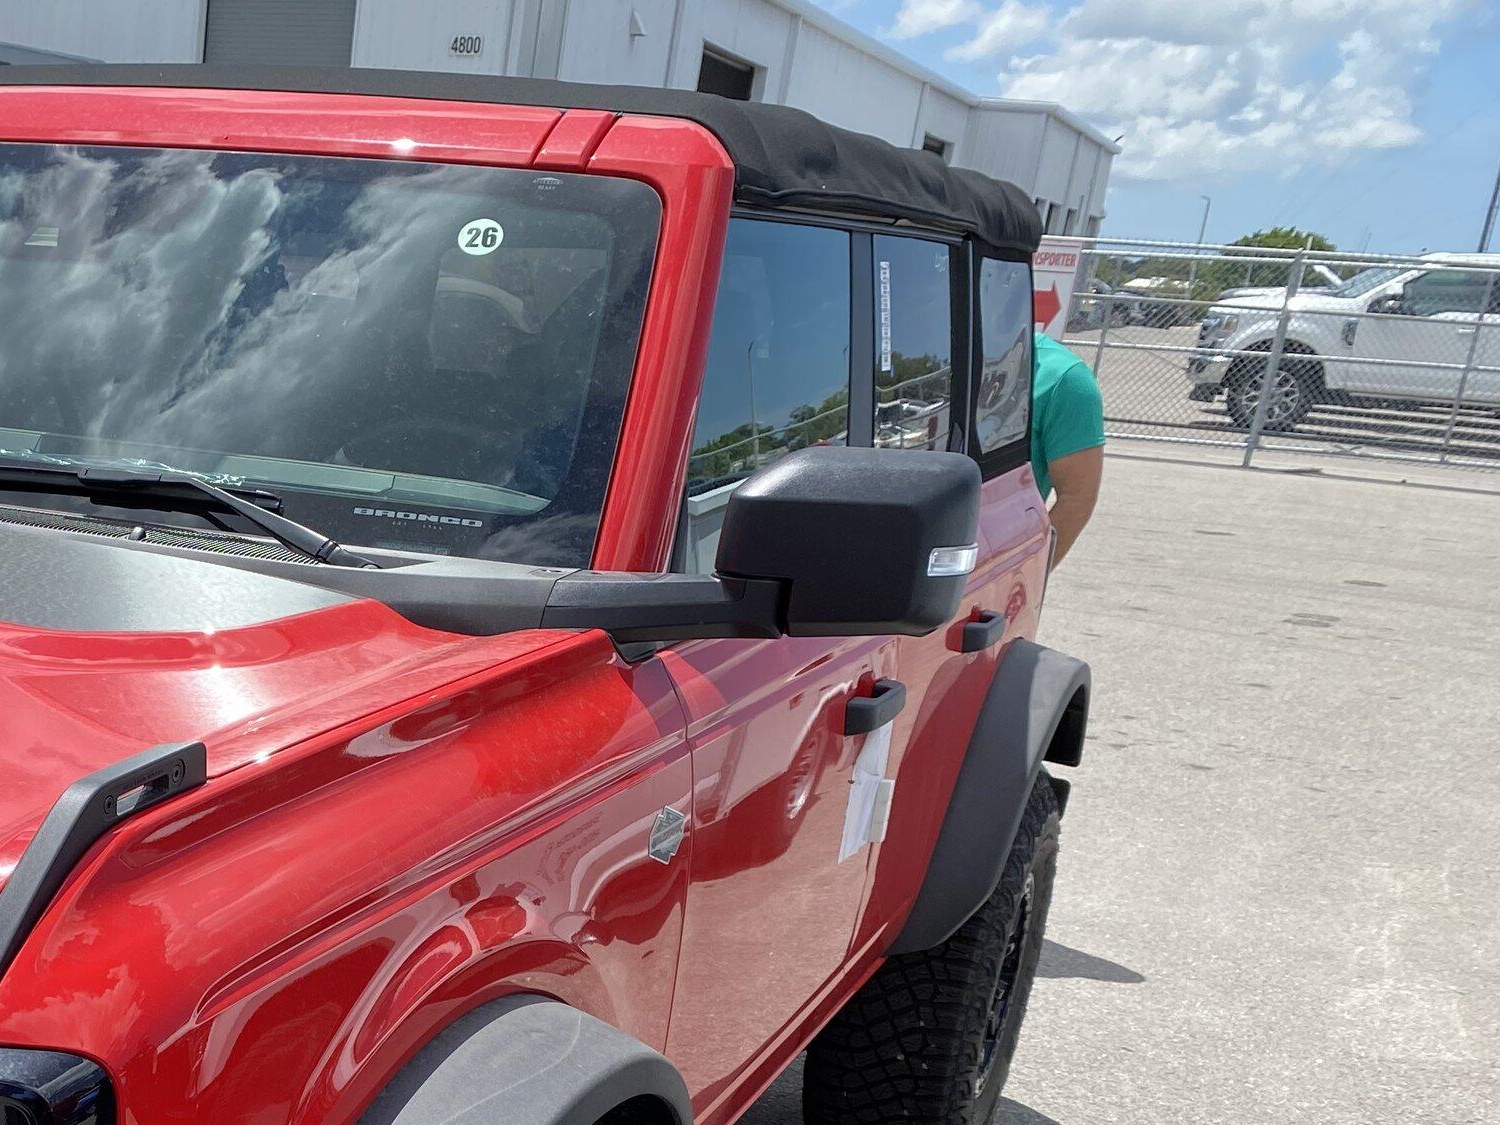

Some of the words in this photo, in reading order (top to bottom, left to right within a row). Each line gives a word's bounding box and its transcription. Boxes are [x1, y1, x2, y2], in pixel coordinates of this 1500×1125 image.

[451, 36, 481, 53] 4800
[465, 227, 498, 247] 26
[353, 507, 482, 527] BRONCO
